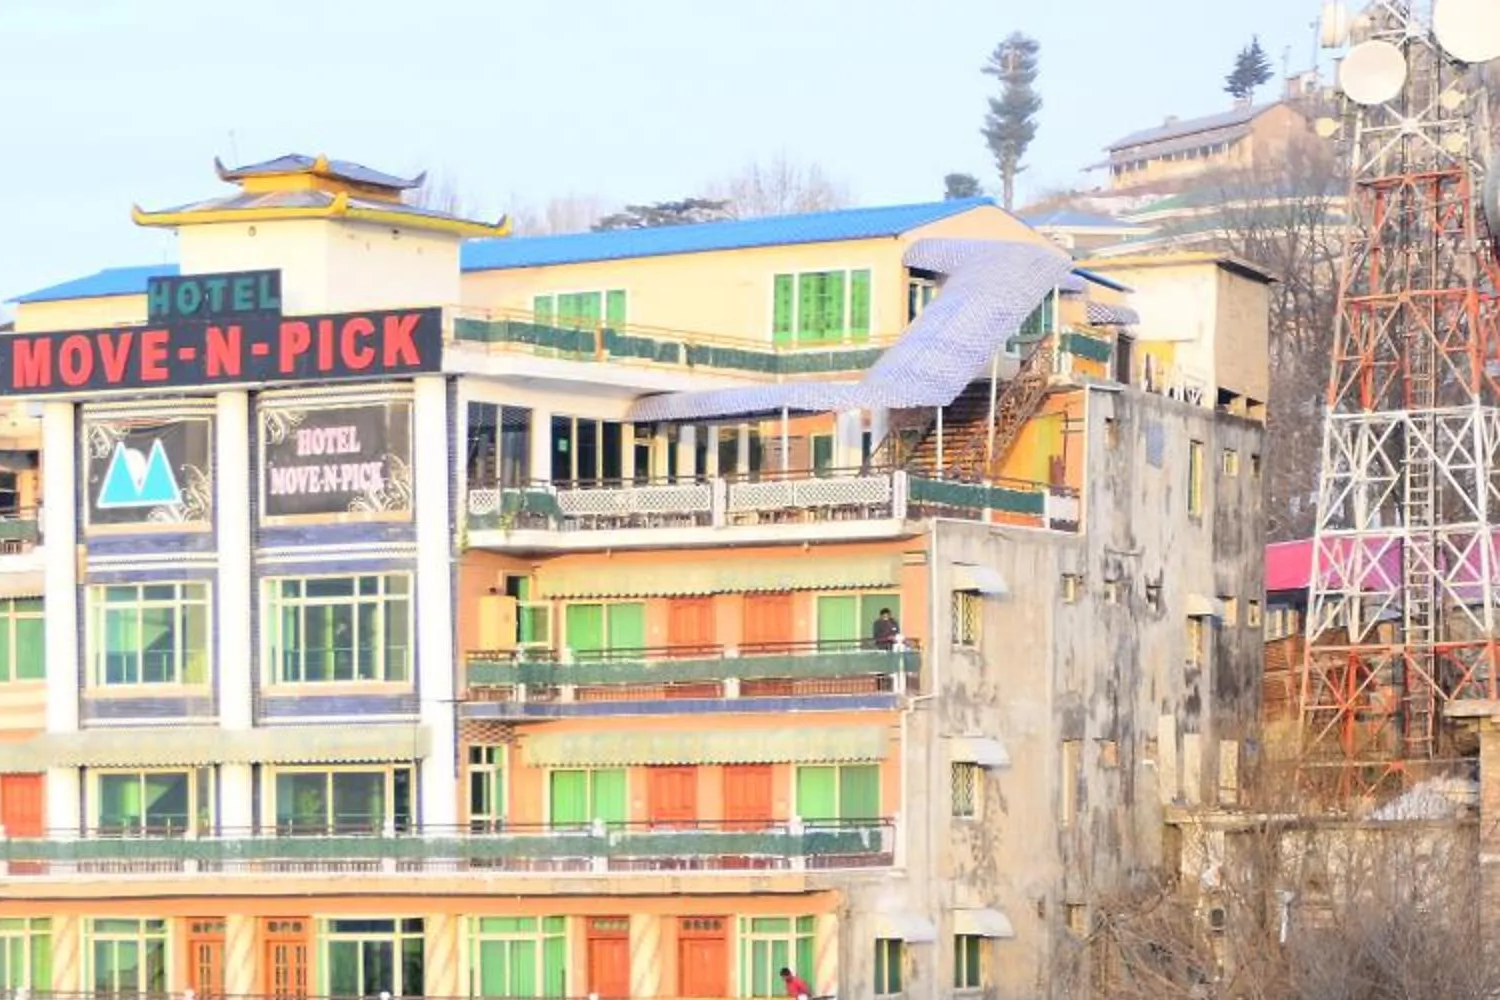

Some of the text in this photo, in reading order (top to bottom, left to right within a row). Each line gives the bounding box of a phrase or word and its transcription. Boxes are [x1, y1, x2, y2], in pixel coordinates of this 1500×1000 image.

[149, 276, 280, 313] HOTEL
[13, 314, 422, 388] MOVE-N-PICK
[297, 426, 361, 456] HOTEL
[270, 461, 385, 495] MOVE-N-PICK
